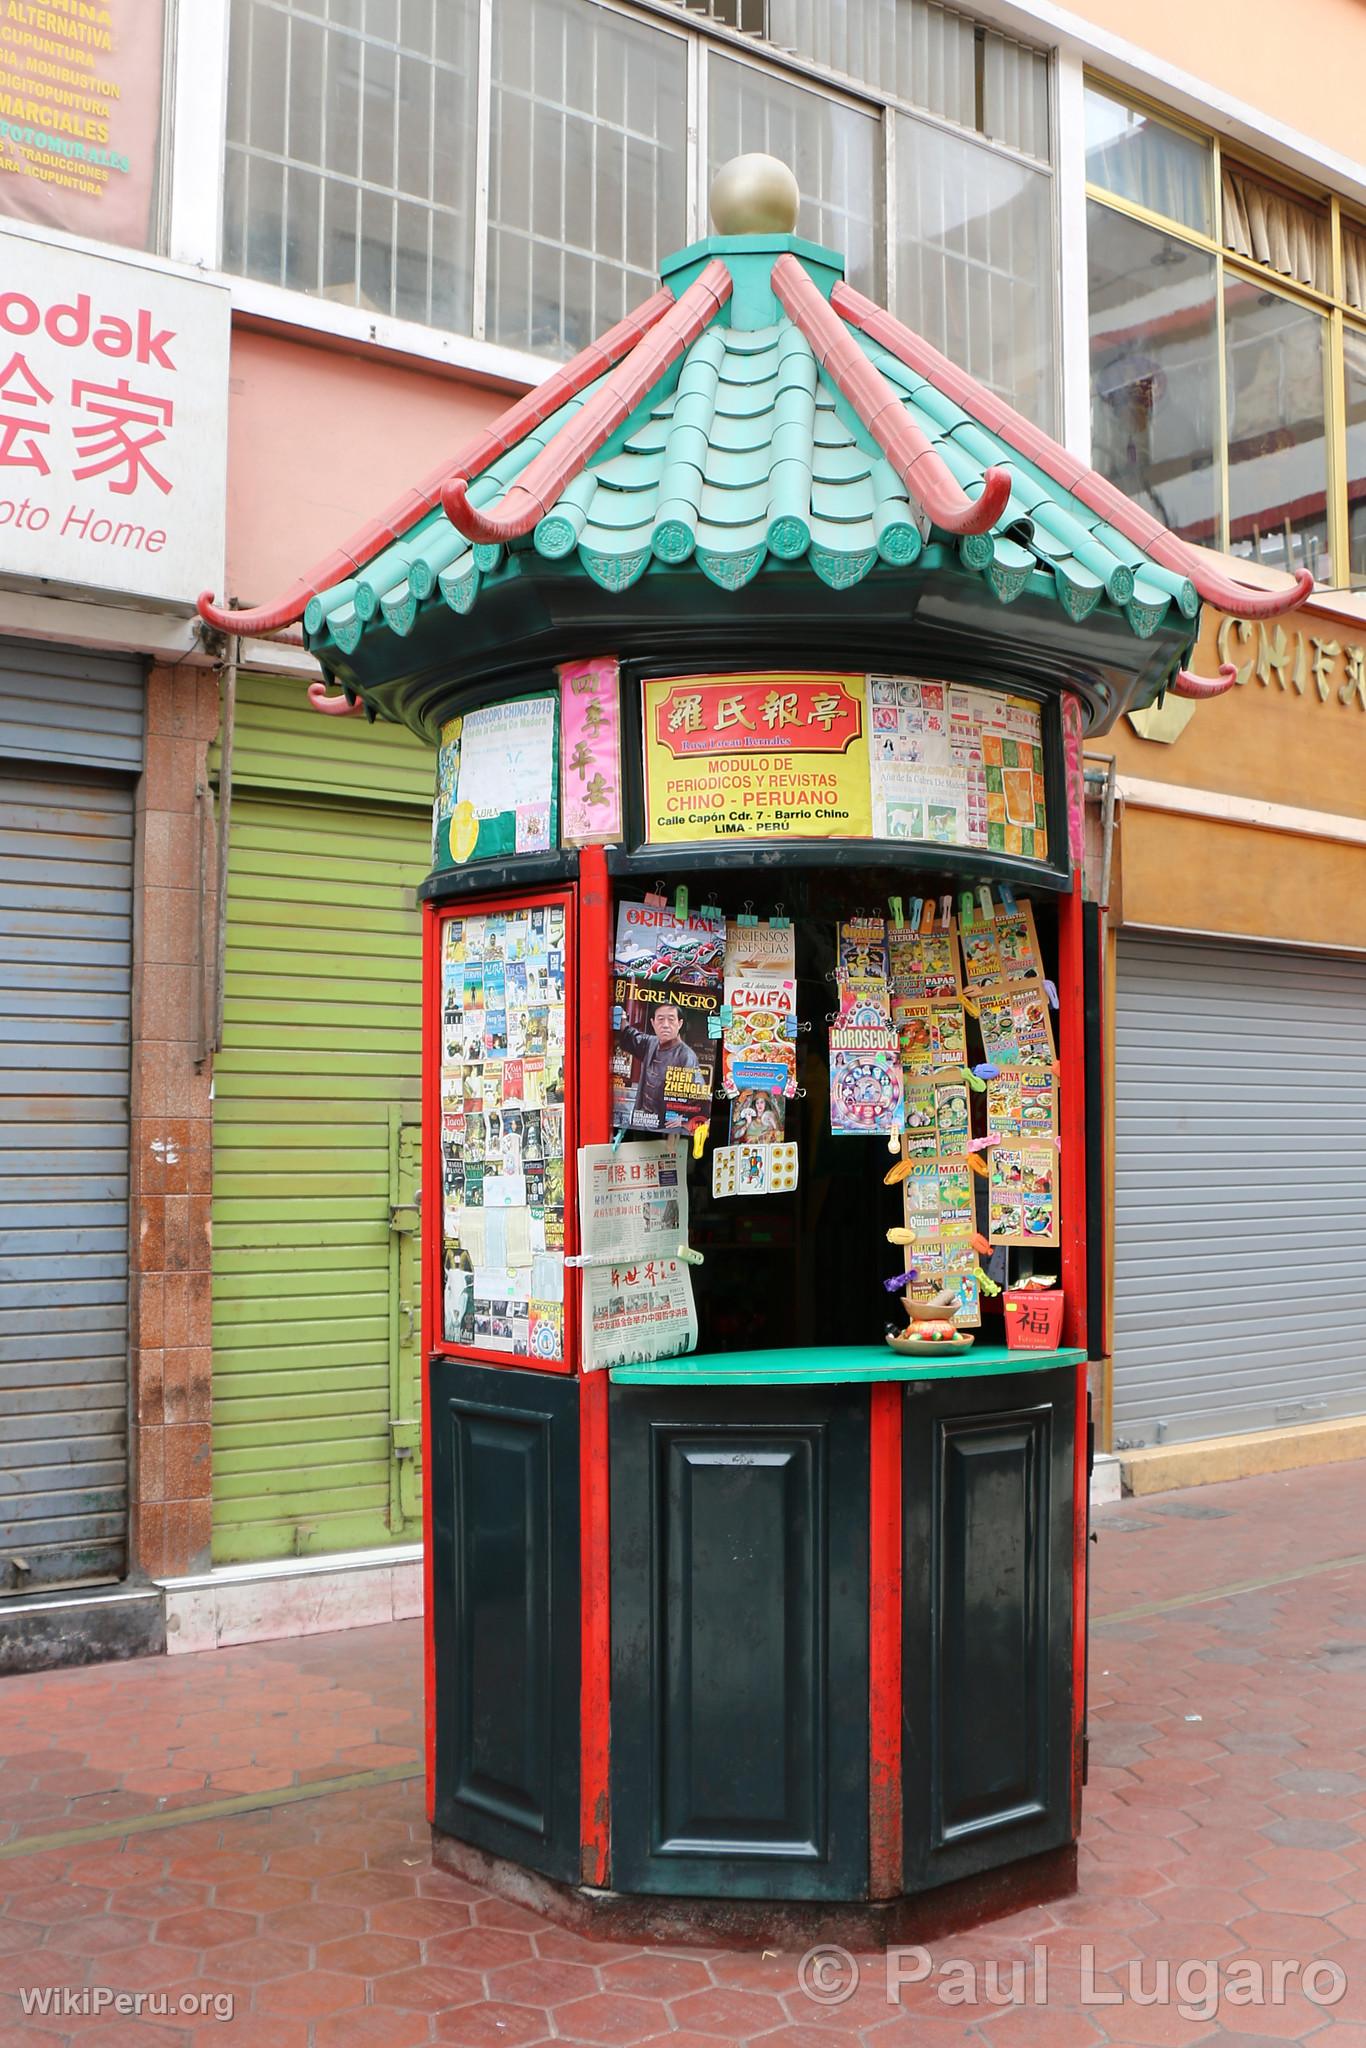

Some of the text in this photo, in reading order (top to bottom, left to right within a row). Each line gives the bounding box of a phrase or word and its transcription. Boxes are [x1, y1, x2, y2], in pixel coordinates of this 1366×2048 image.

[8, 0, 112, 51] ALTERNATIVA
[26, 55, 120, 98] MOXIBUSTION
[19, 147, 109, 182] TRADUCCIONES
[24, 165, 103, 196] ACUPUNTURA
[60, 505, 168, 553] Home
[667, 690, 848, 733] 羅氏報亭
[708, 758, 793, 774] MODULO DE
[667, 774, 837, 793] PERIODICOS Y REVISTAS
[666, 793, 725, 812] CHINO
[743, 790, 838, 807] PERUANO
[657, 816, 685, 827] Calle
[688, 812, 725, 825] Capón
[729, 811, 753, 821] Cdr.
[756, 811, 763, 820] 7
[775, 810, 811, 819] Barrio
[815, 809, 849, 818] Chino
[715, 824, 745, 834] LIMA
[756, 820, 790, 832] PERÚ
[925, 976, 955, 986] PAPAS
[669, 990, 718, 1010] NEGRO
[731, 989, 791, 1010] CHIFA
[831, 1029, 898, 1050] HOROSCOPO
[665, 1071, 693, 1082] CHEN
[664, 1081, 711, 1095] ZHENGLEI
[940, 1165, 969, 1174] MACA
[1016, 1303, 1050, 1335] 福
